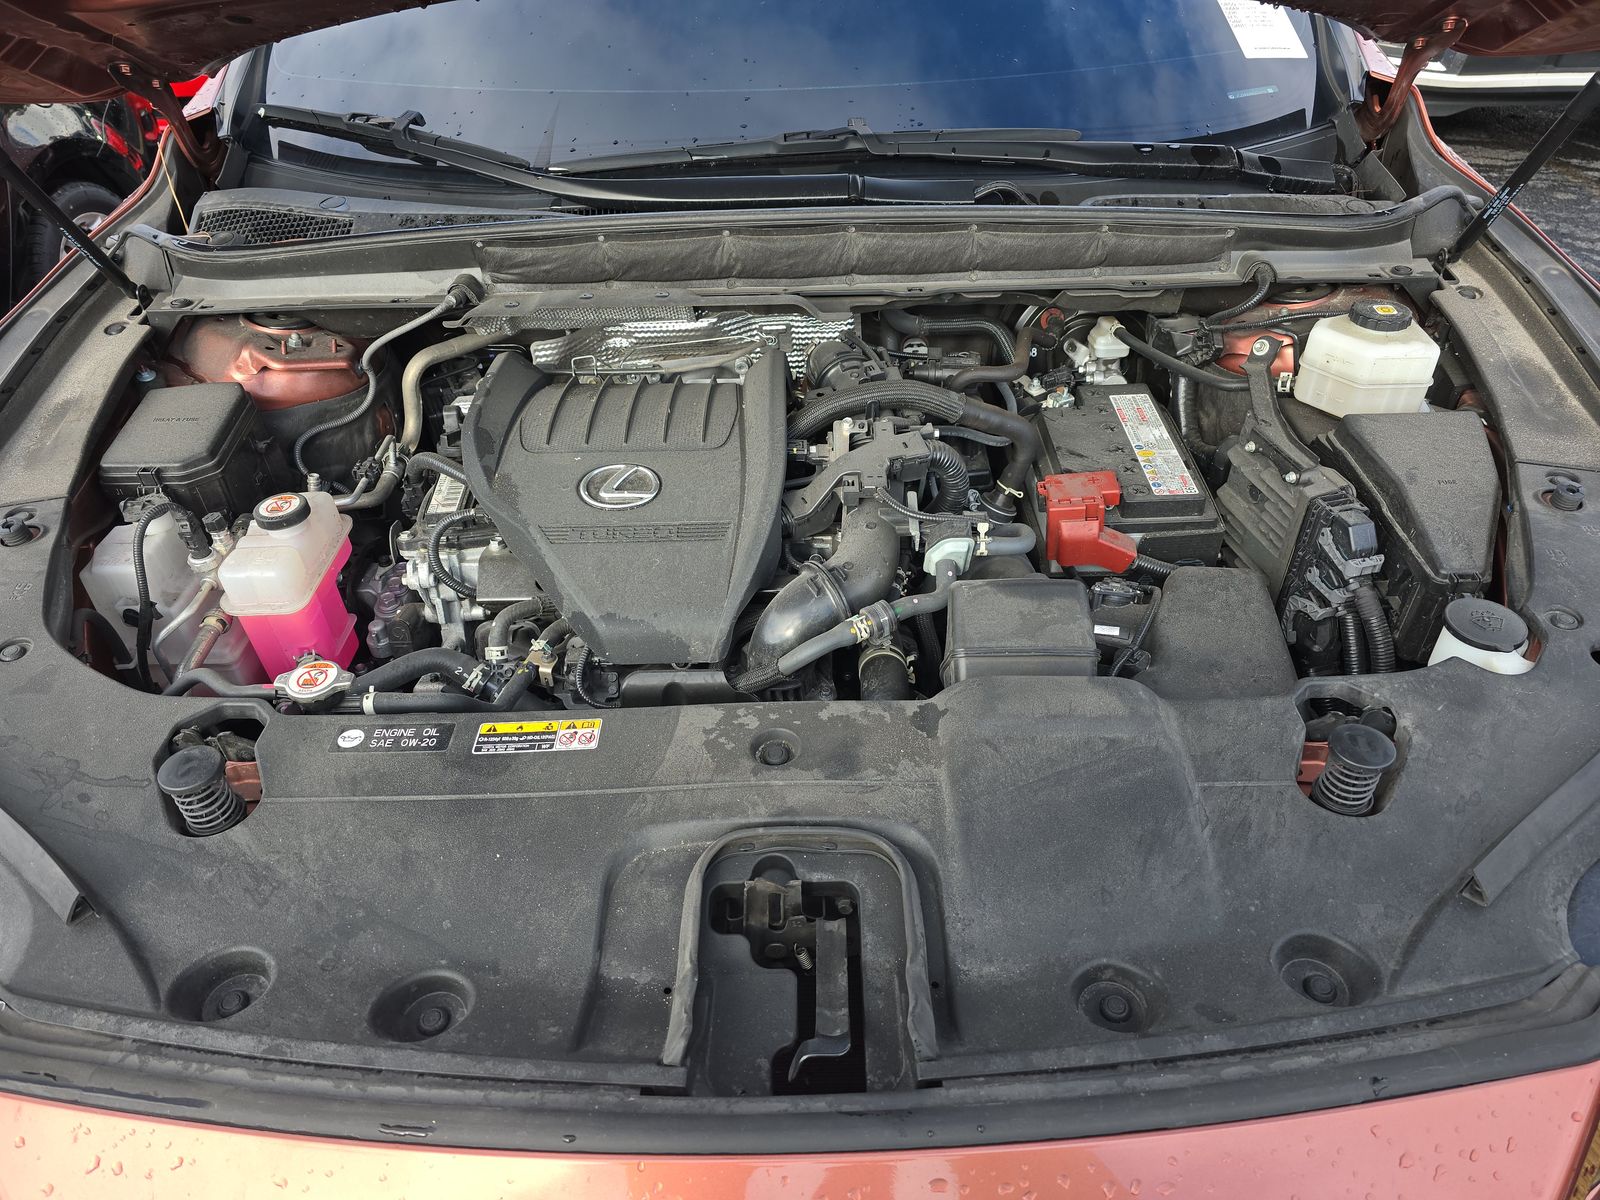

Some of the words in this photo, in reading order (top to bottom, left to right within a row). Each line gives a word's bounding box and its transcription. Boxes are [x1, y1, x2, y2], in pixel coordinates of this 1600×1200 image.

[373, 728, 416, 737] ENGINE
[422, 728, 440, 736] OIL
[369, 739, 394, 748] SAE
[400, 738, 437, 747] 0W-20
